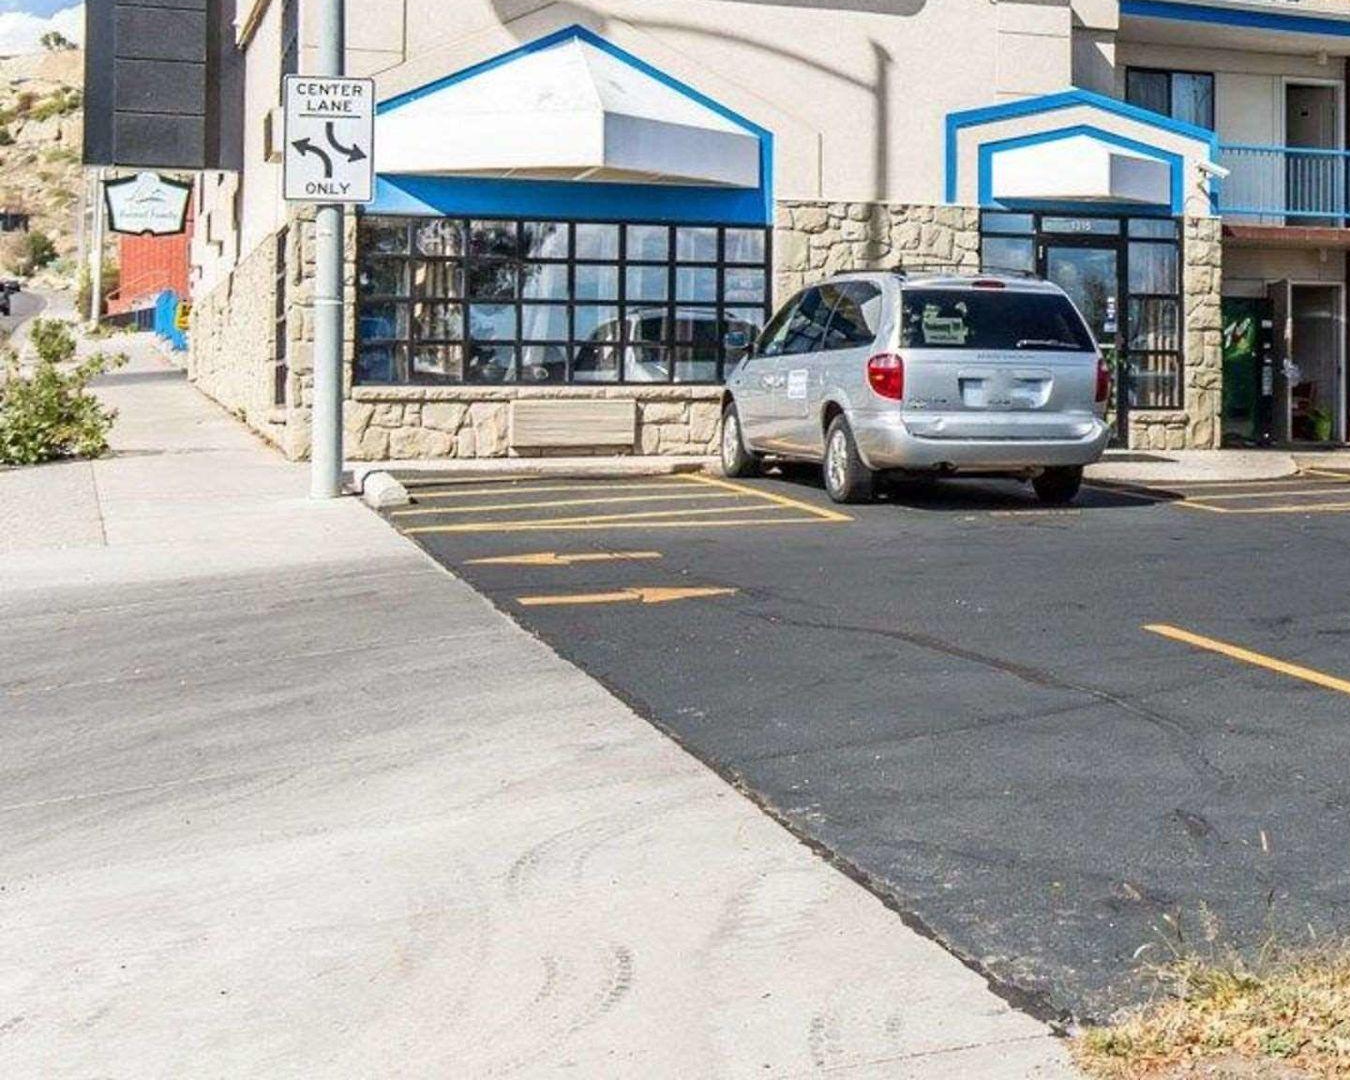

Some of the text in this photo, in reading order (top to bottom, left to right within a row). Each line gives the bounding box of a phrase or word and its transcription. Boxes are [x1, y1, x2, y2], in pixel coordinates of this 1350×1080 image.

[296, 83, 363, 97] CENTER
[306, 100, 353, 112] LANE
[305, 182, 351, 195] ONLY
